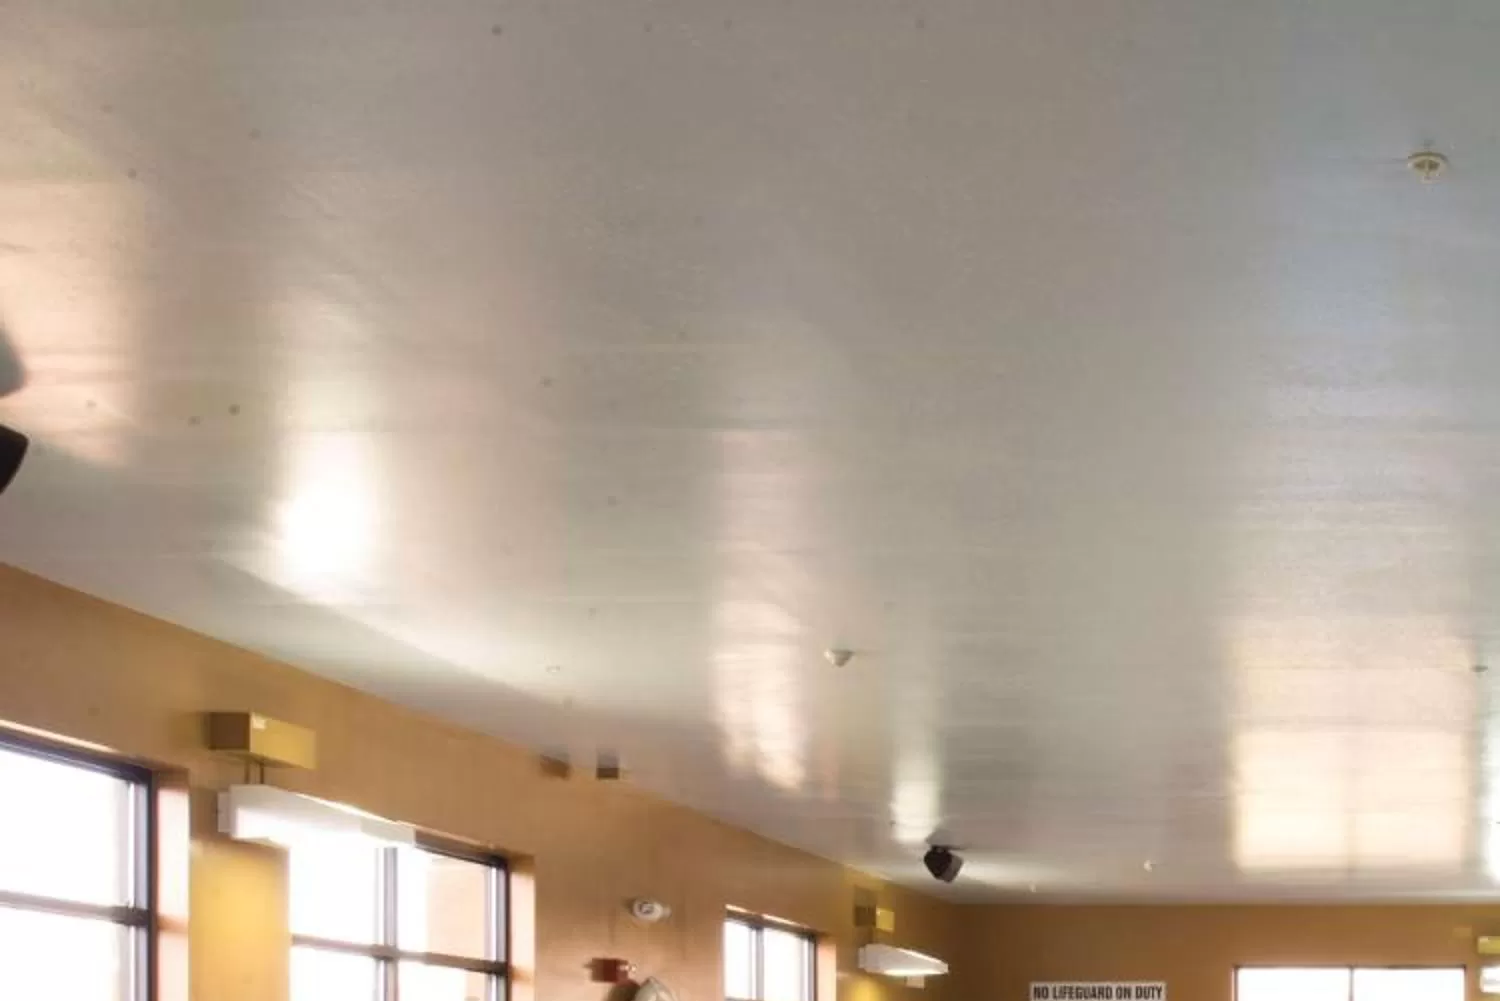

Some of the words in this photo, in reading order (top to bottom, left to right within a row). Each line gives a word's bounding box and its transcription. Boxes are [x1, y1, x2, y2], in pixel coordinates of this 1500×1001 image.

[1034, 985, 1049, 999] NO
[1052, 985, 1112, 999] LIFEGUARD
[1115, 985, 1132, 999] ON
[1135, 985, 1163, 999] DUTY
